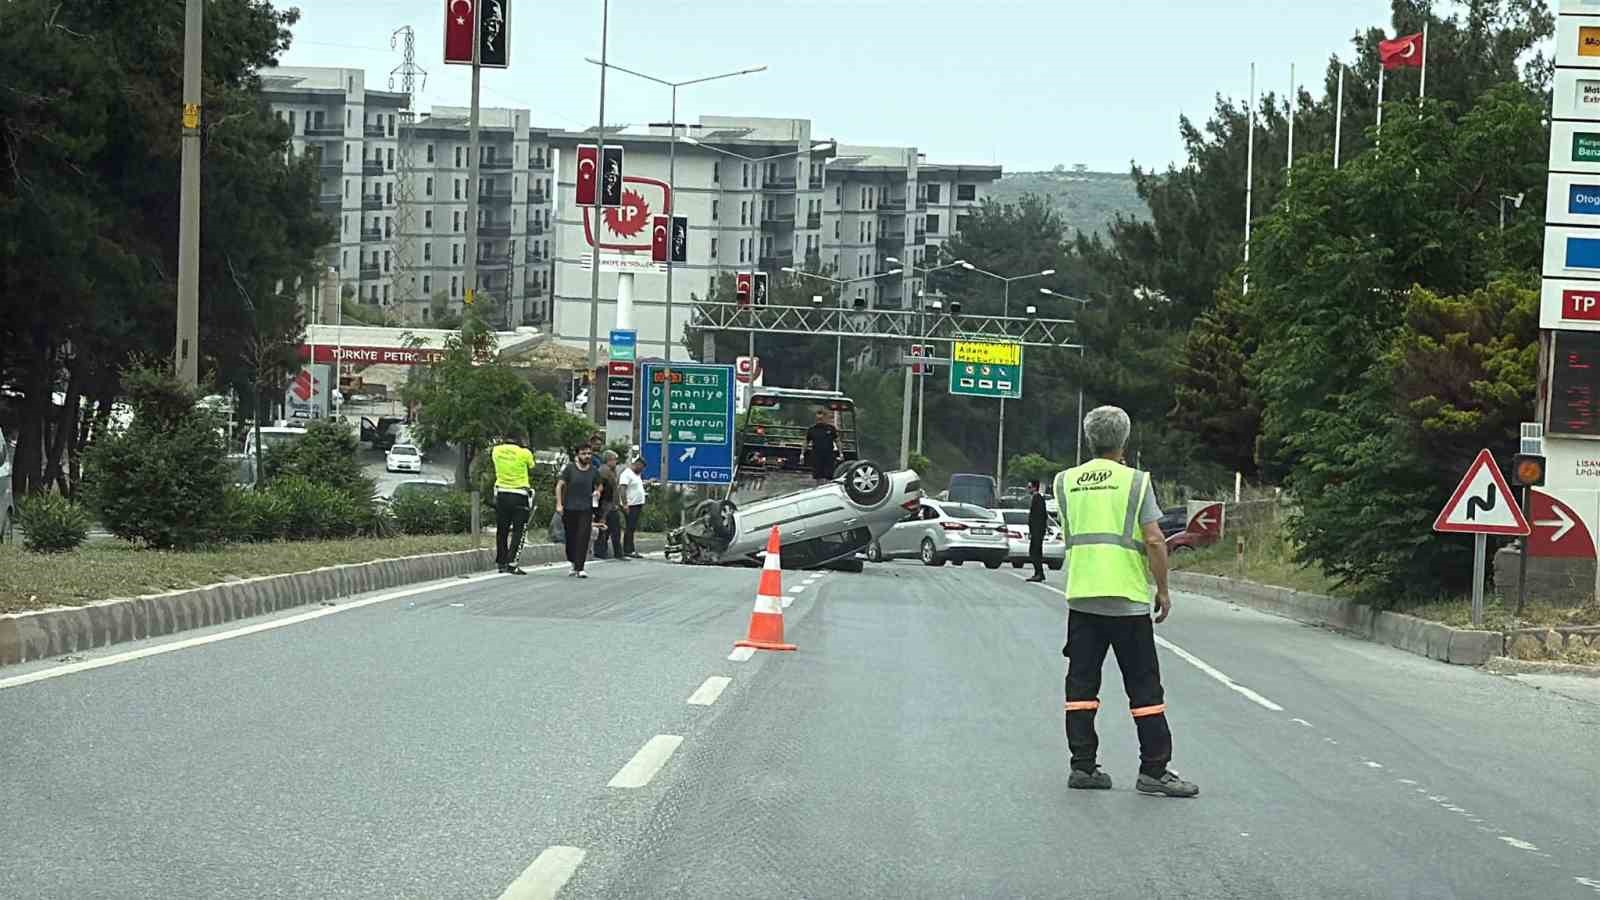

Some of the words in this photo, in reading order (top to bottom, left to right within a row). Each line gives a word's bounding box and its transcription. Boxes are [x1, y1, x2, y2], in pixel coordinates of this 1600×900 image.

[616, 206, 638, 222] TP
[1571, 295, 1596, 312] TP
[652, 387, 723, 400] Omaniye
[652, 400, 696, 410] Aana
[651, 412, 724, 427] İsenderun
[694, 471, 729, 480] 400m
